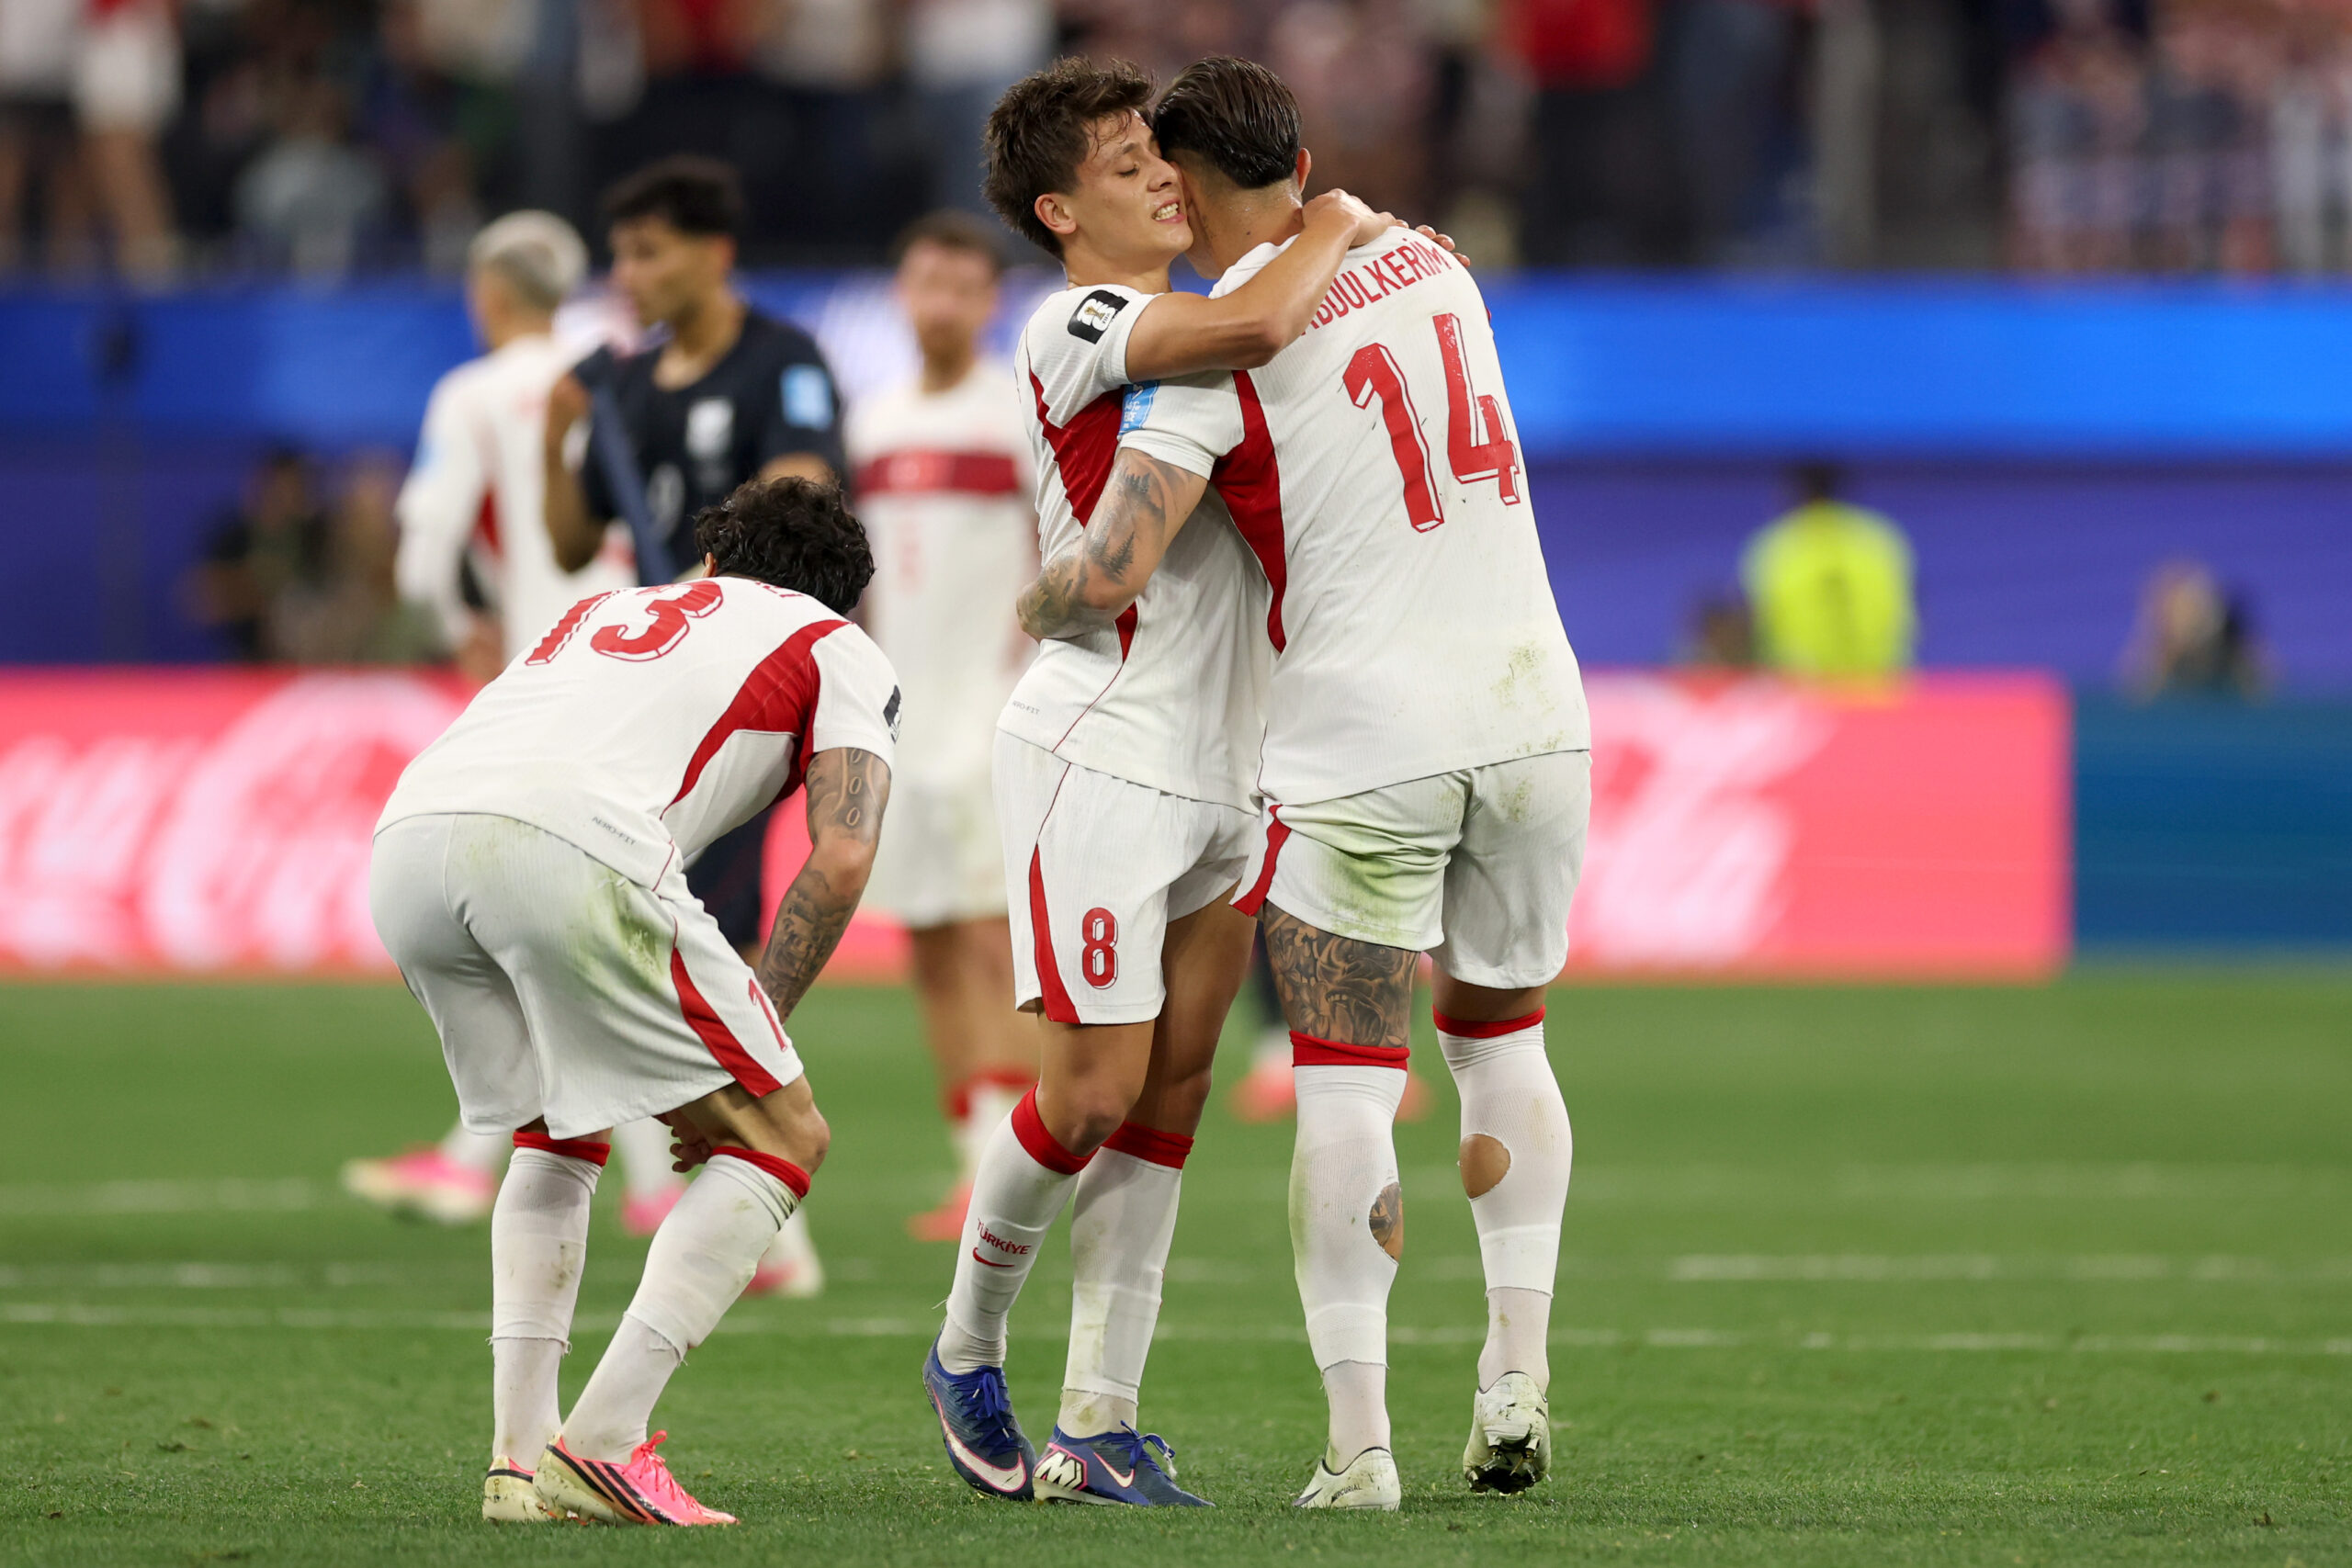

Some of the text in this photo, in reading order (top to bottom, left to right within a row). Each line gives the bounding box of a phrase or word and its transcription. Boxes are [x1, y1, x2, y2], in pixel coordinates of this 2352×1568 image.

[1301, 237, 1453, 336] BDULKERİM
[1342, 312, 1521, 534] 14
[525, 580, 724, 666] 13
[1081, 907, 1119, 990] 8
[977, 1217, 1033, 1256] TÜRKİYE
